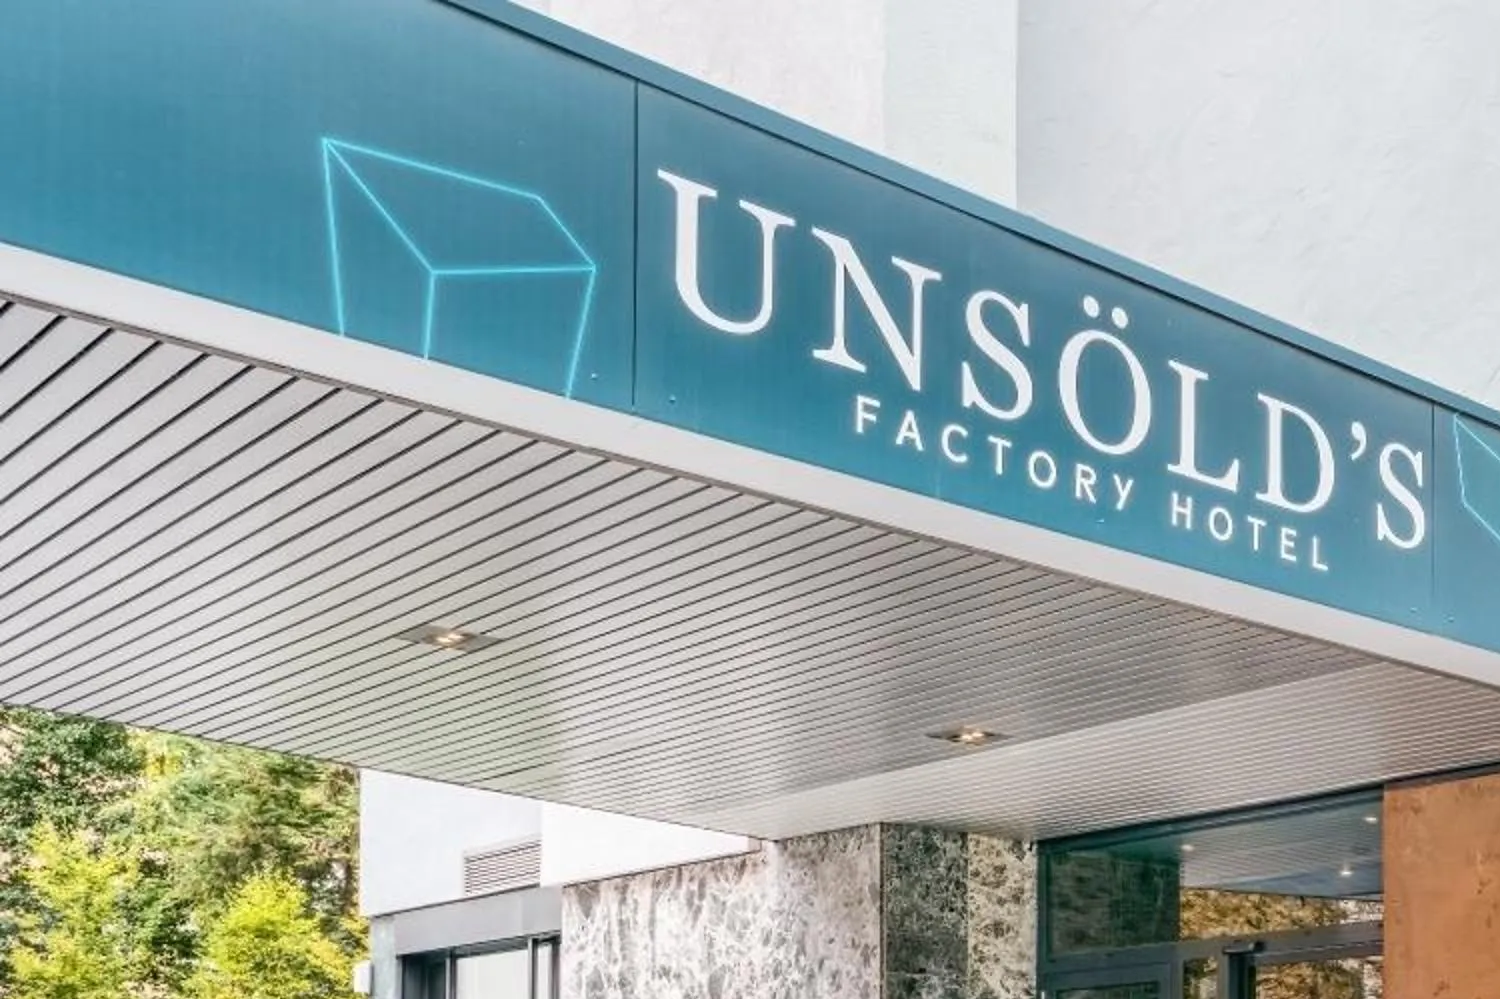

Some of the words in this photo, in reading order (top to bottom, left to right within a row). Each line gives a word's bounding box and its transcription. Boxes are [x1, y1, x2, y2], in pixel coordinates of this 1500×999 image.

[657, 169, 1426, 550] UNSÖLD'S
[854, 395, 1134, 512] FACTORY
[1170, 492, 1330, 572] HOTEL
